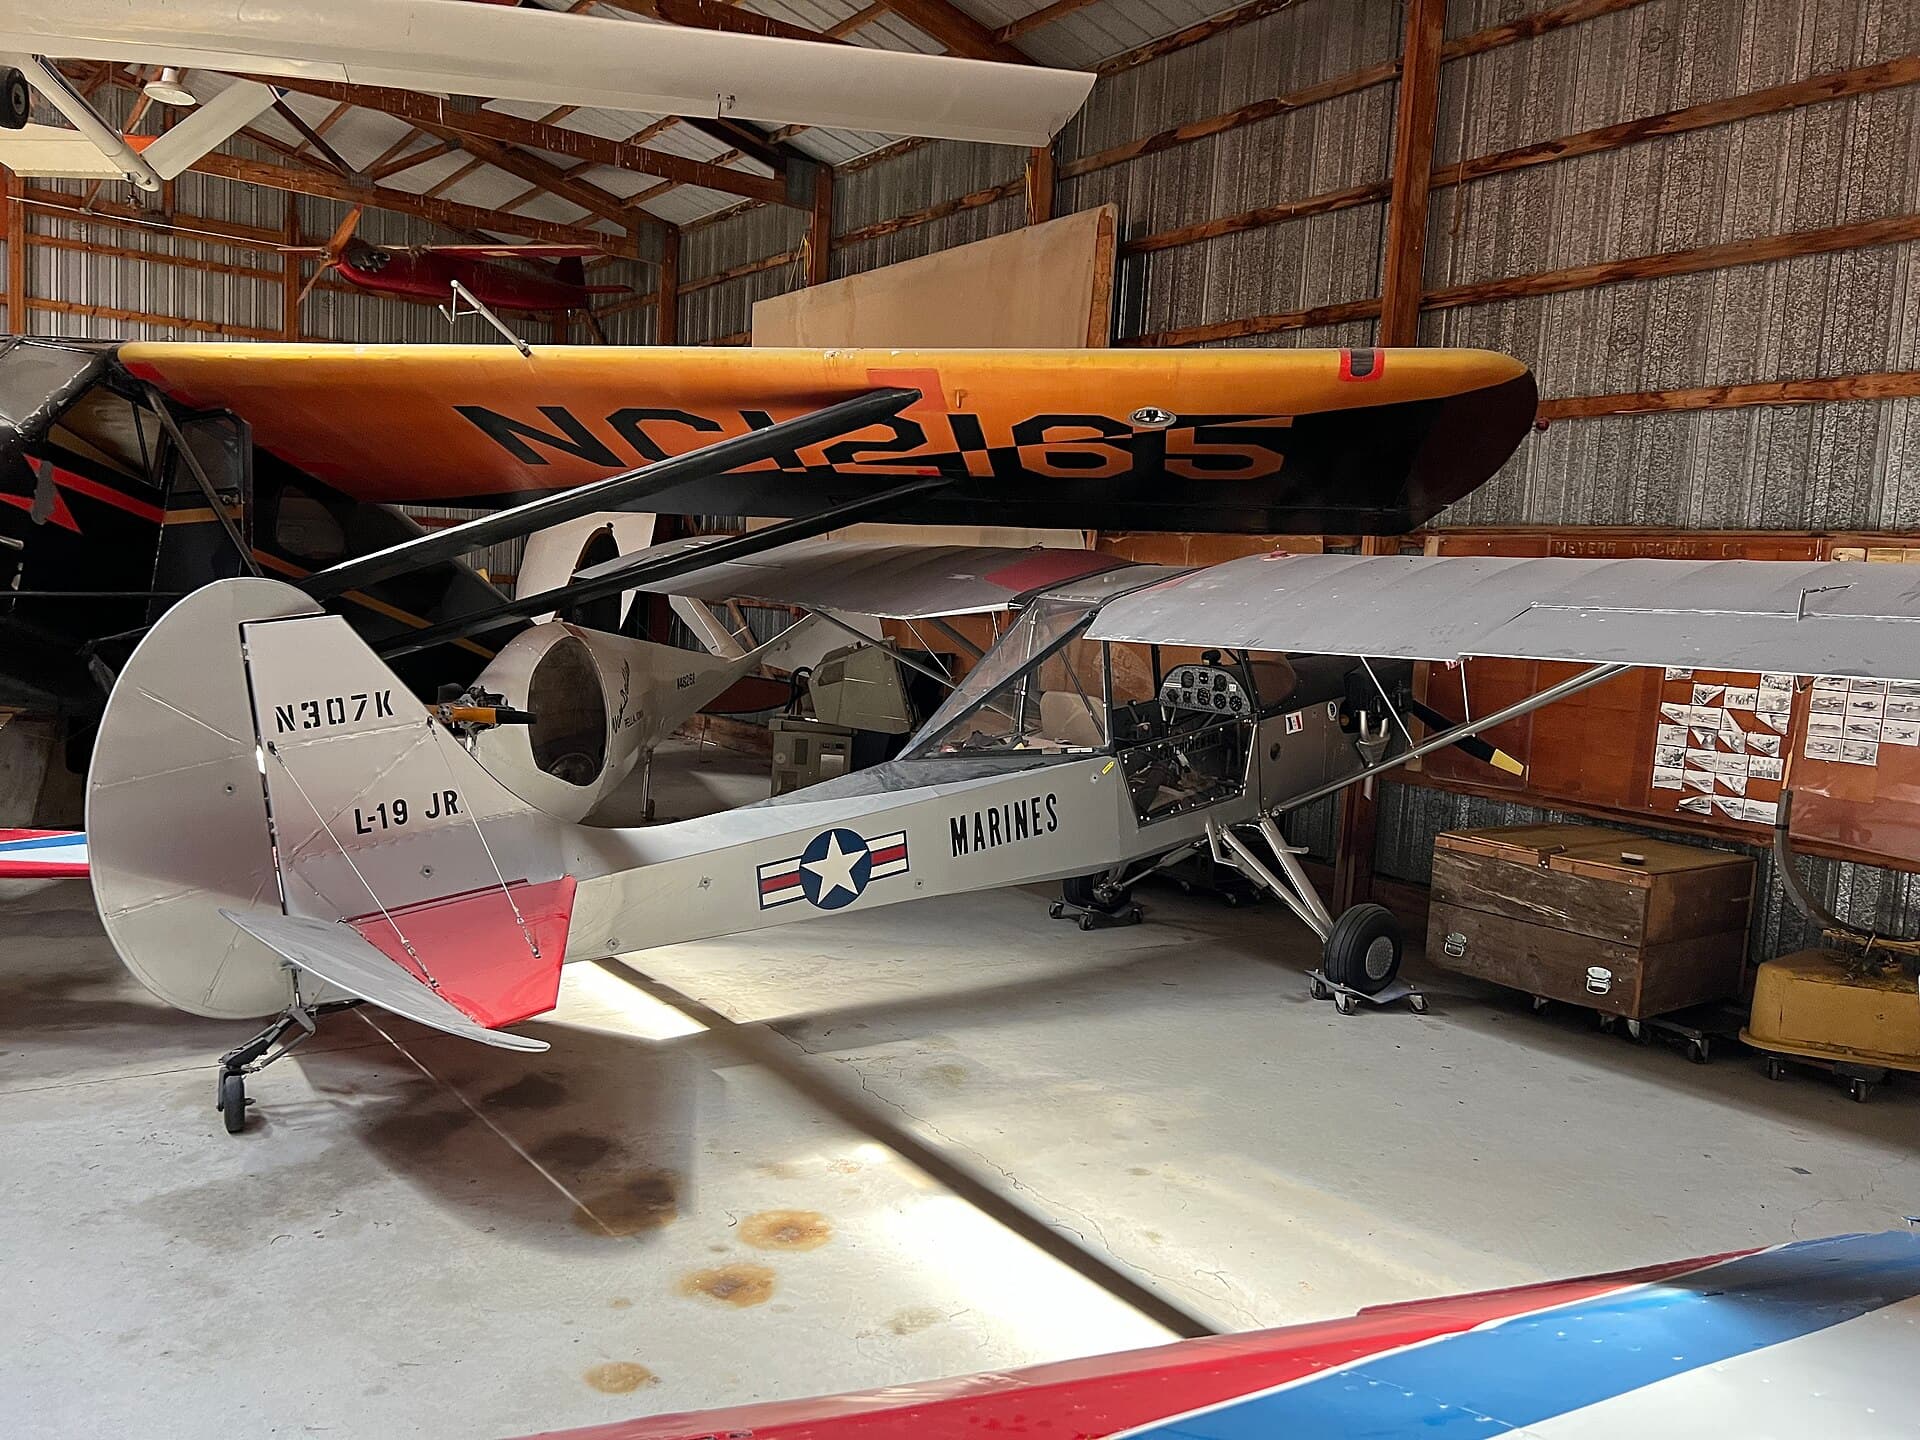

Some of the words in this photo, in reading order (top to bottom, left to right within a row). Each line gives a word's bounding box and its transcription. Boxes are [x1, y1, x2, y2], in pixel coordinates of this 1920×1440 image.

[275, 690, 394, 733] N307K
[354, 798, 409, 835] L-19
[424, 789, 464, 819] JR.
[949, 793, 1058, 858] MARINES
